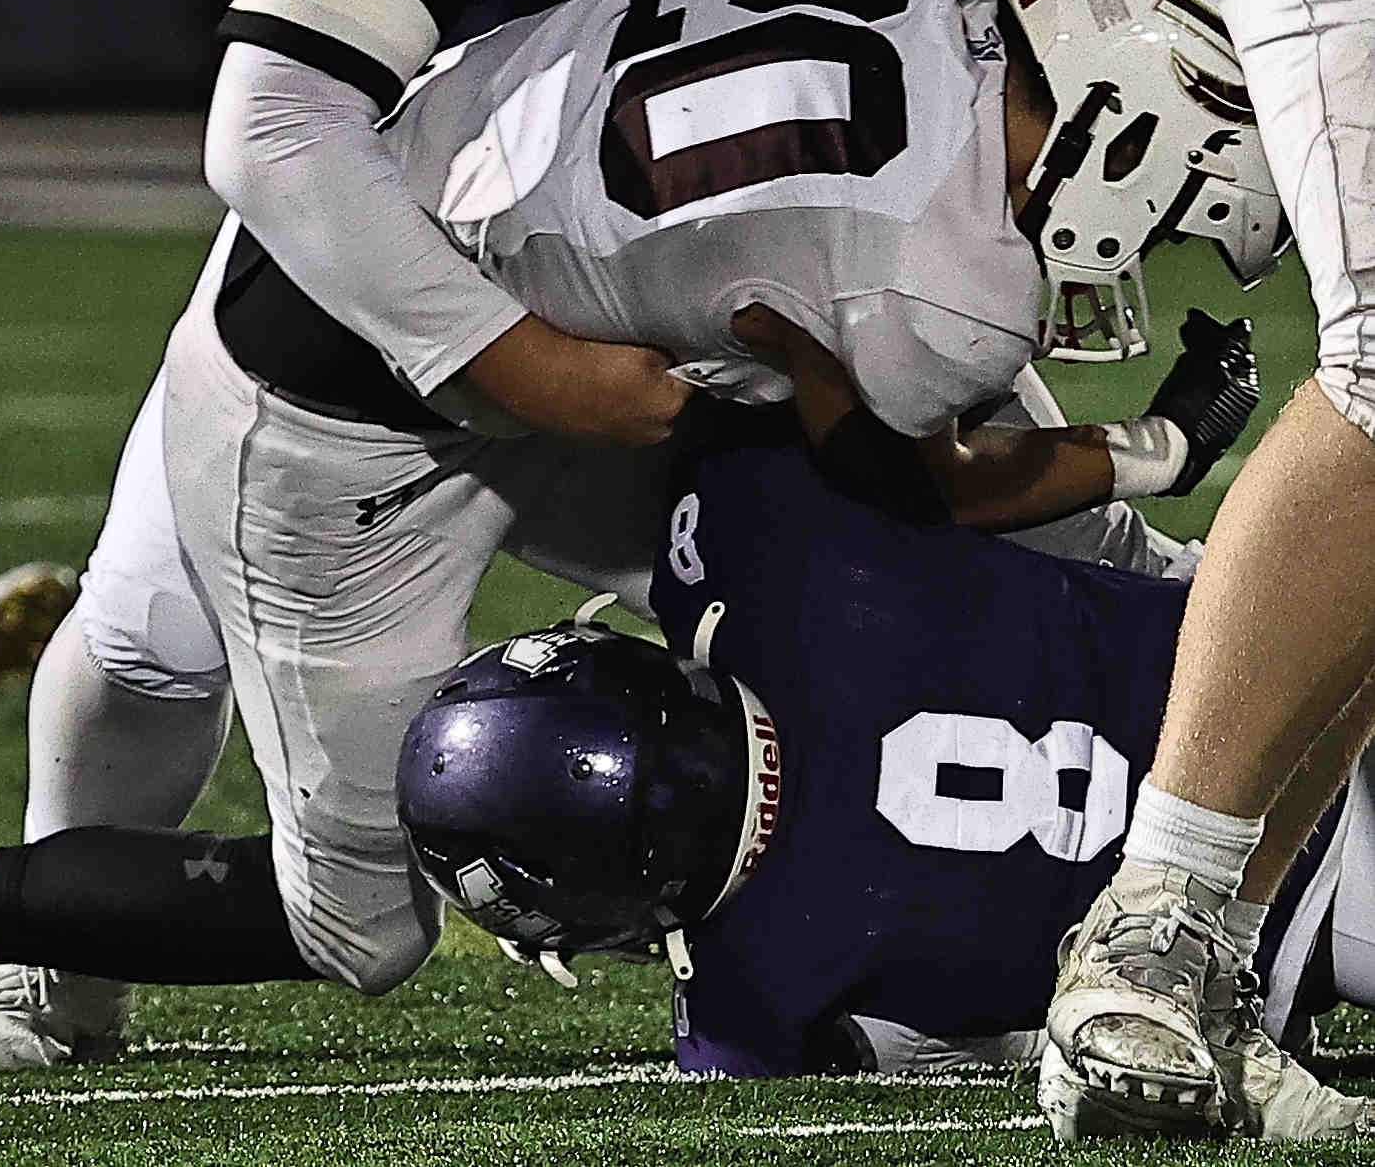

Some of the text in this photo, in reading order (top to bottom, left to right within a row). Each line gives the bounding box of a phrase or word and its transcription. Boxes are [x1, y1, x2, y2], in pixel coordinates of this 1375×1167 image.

[669, 492, 705, 585] 8
[738, 714, 780, 876] Riddell
[875, 711, 1129, 862] 8
